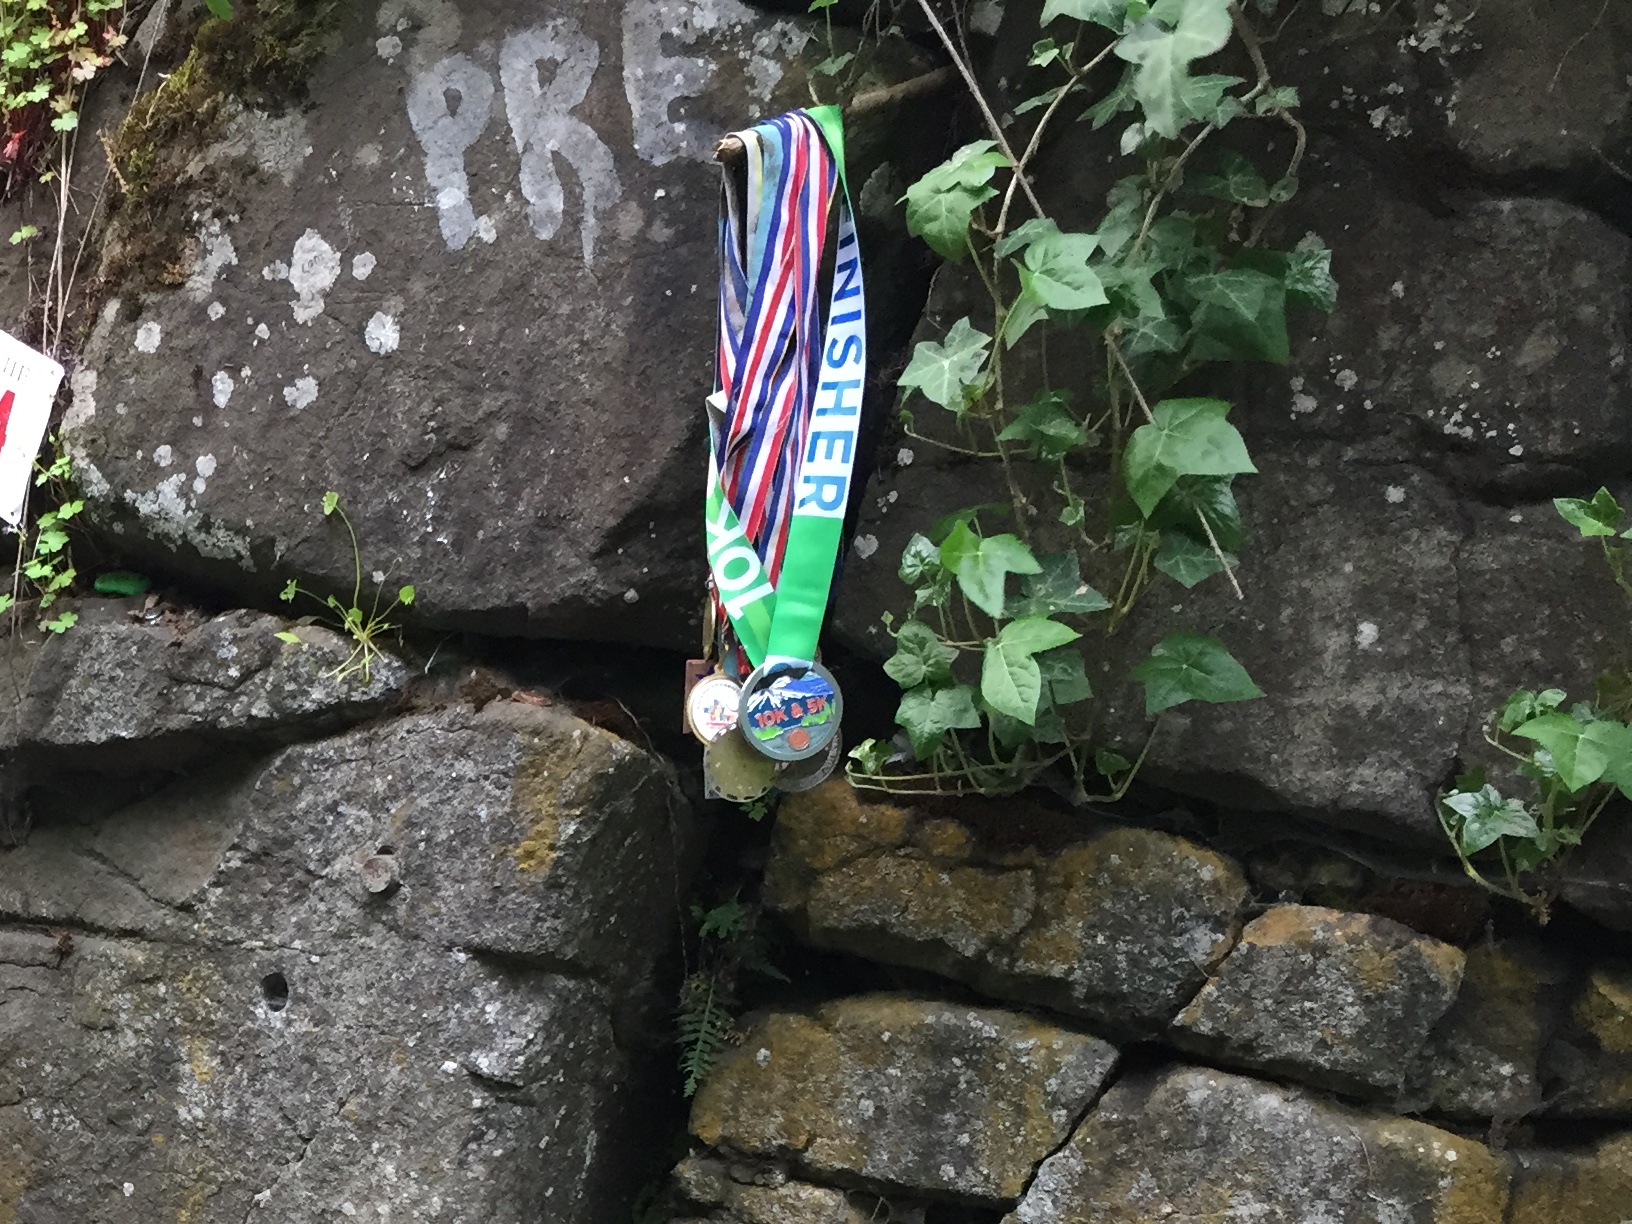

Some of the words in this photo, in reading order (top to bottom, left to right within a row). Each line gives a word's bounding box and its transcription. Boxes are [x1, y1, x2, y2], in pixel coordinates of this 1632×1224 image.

[406, 0, 758, 268] PRE
[705, 495, 774, 621] 10K
[755, 704, 789, 729] 10K
[806, 695, 829, 714] 5K
